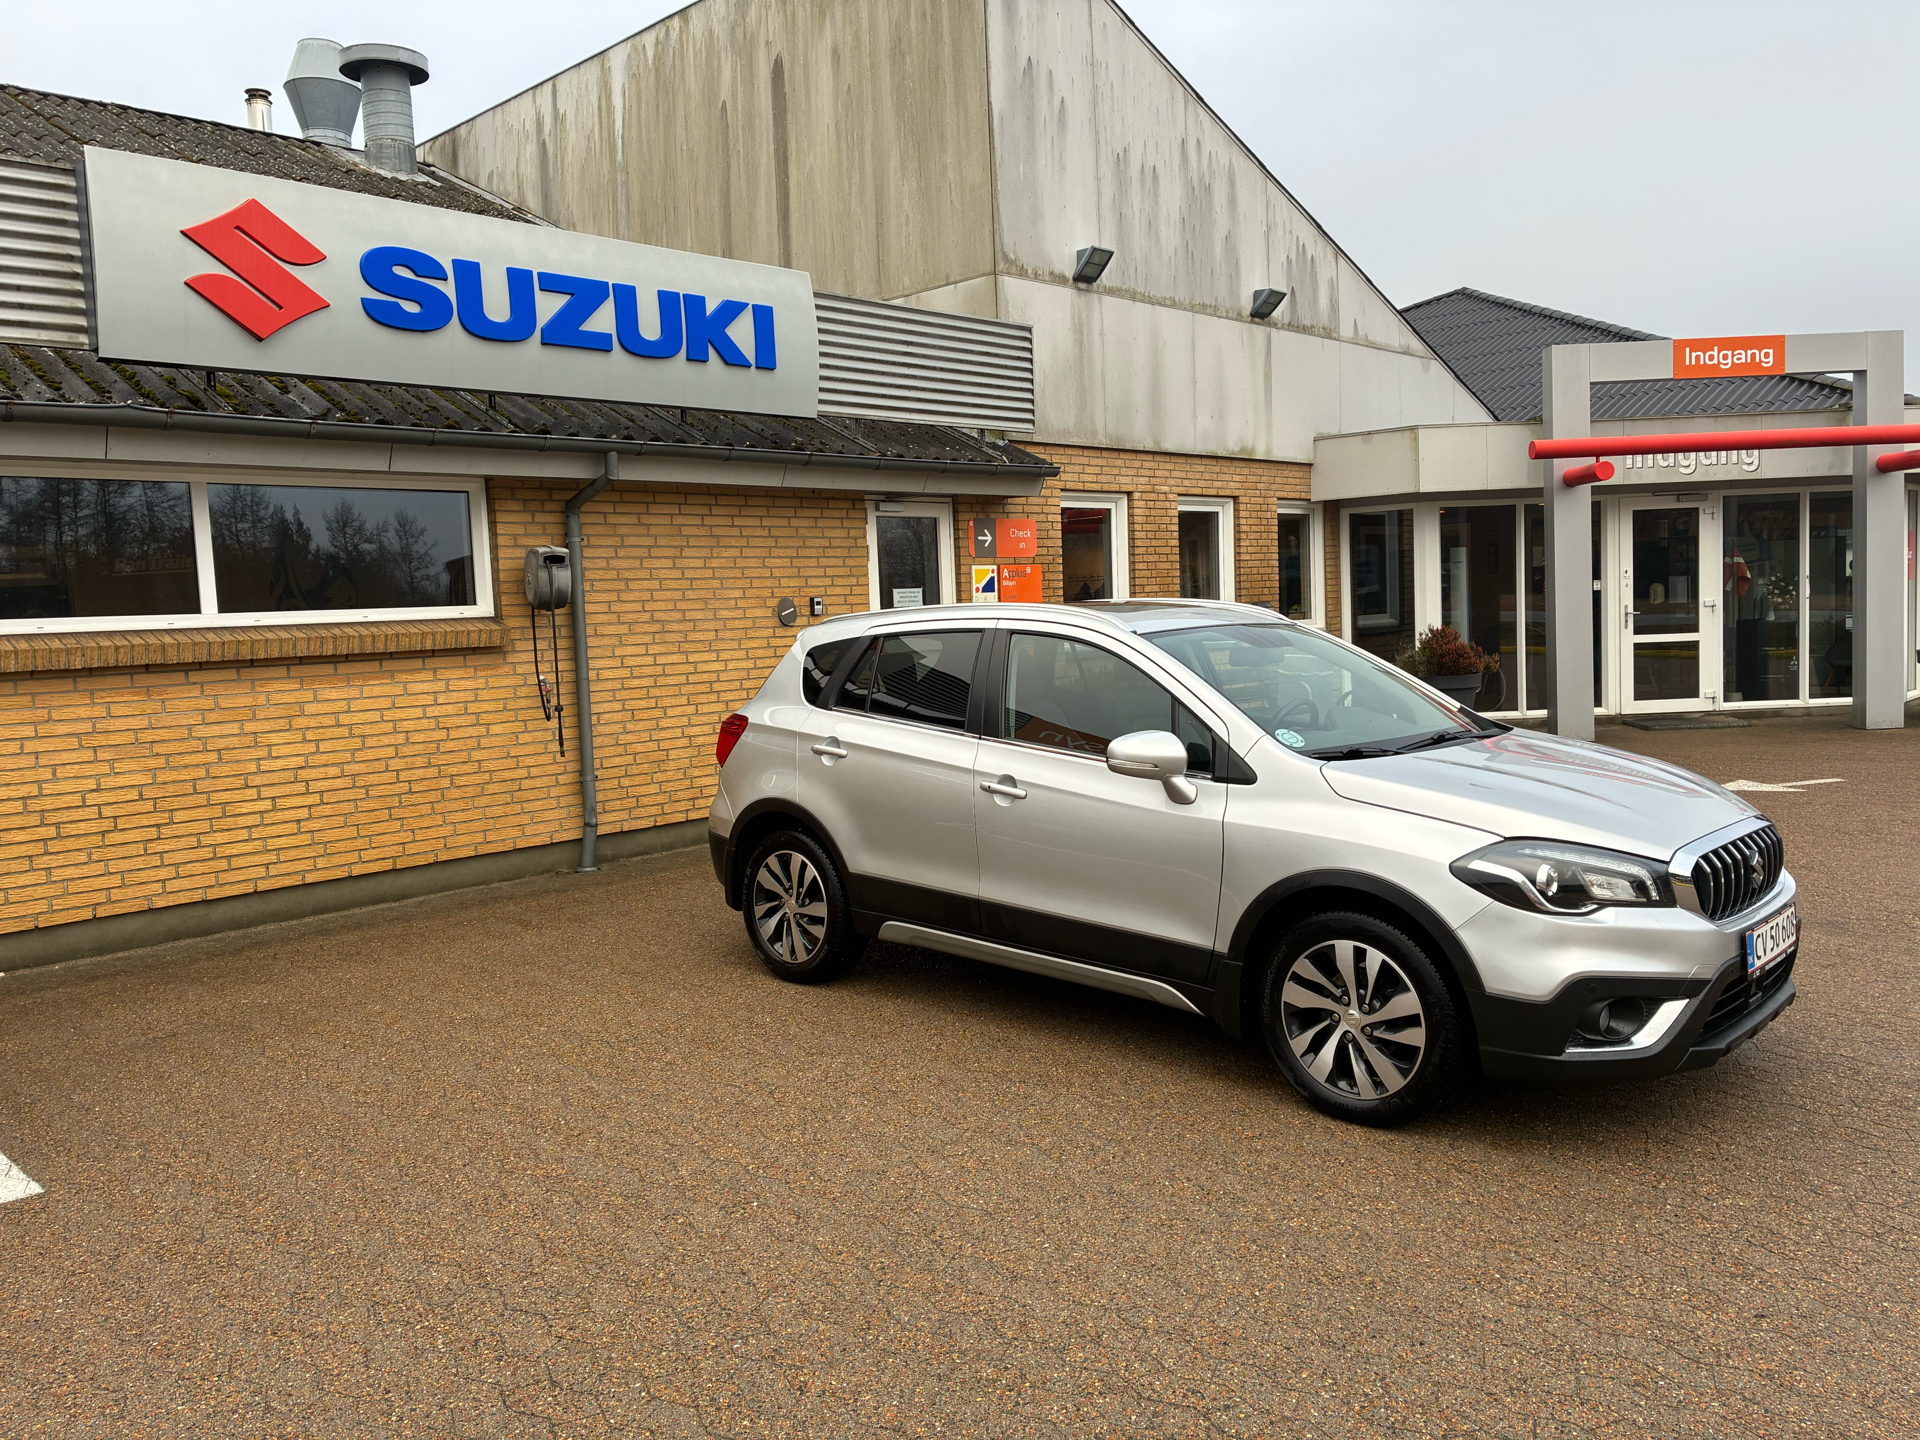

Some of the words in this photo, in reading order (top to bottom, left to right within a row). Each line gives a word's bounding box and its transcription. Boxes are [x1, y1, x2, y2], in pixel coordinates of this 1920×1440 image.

[359, 245, 777, 370] SUZUKI
[1685, 346, 1774, 369] Indgang
[1009, 528, 1032, 538] Check
[1755, 929, 1768, 961] CV
[1769, 921, 1780, 953] 50
[1781, 910, 1795, 943] 608
[1262, 945, 1289, 1025] AllSeasonContact
